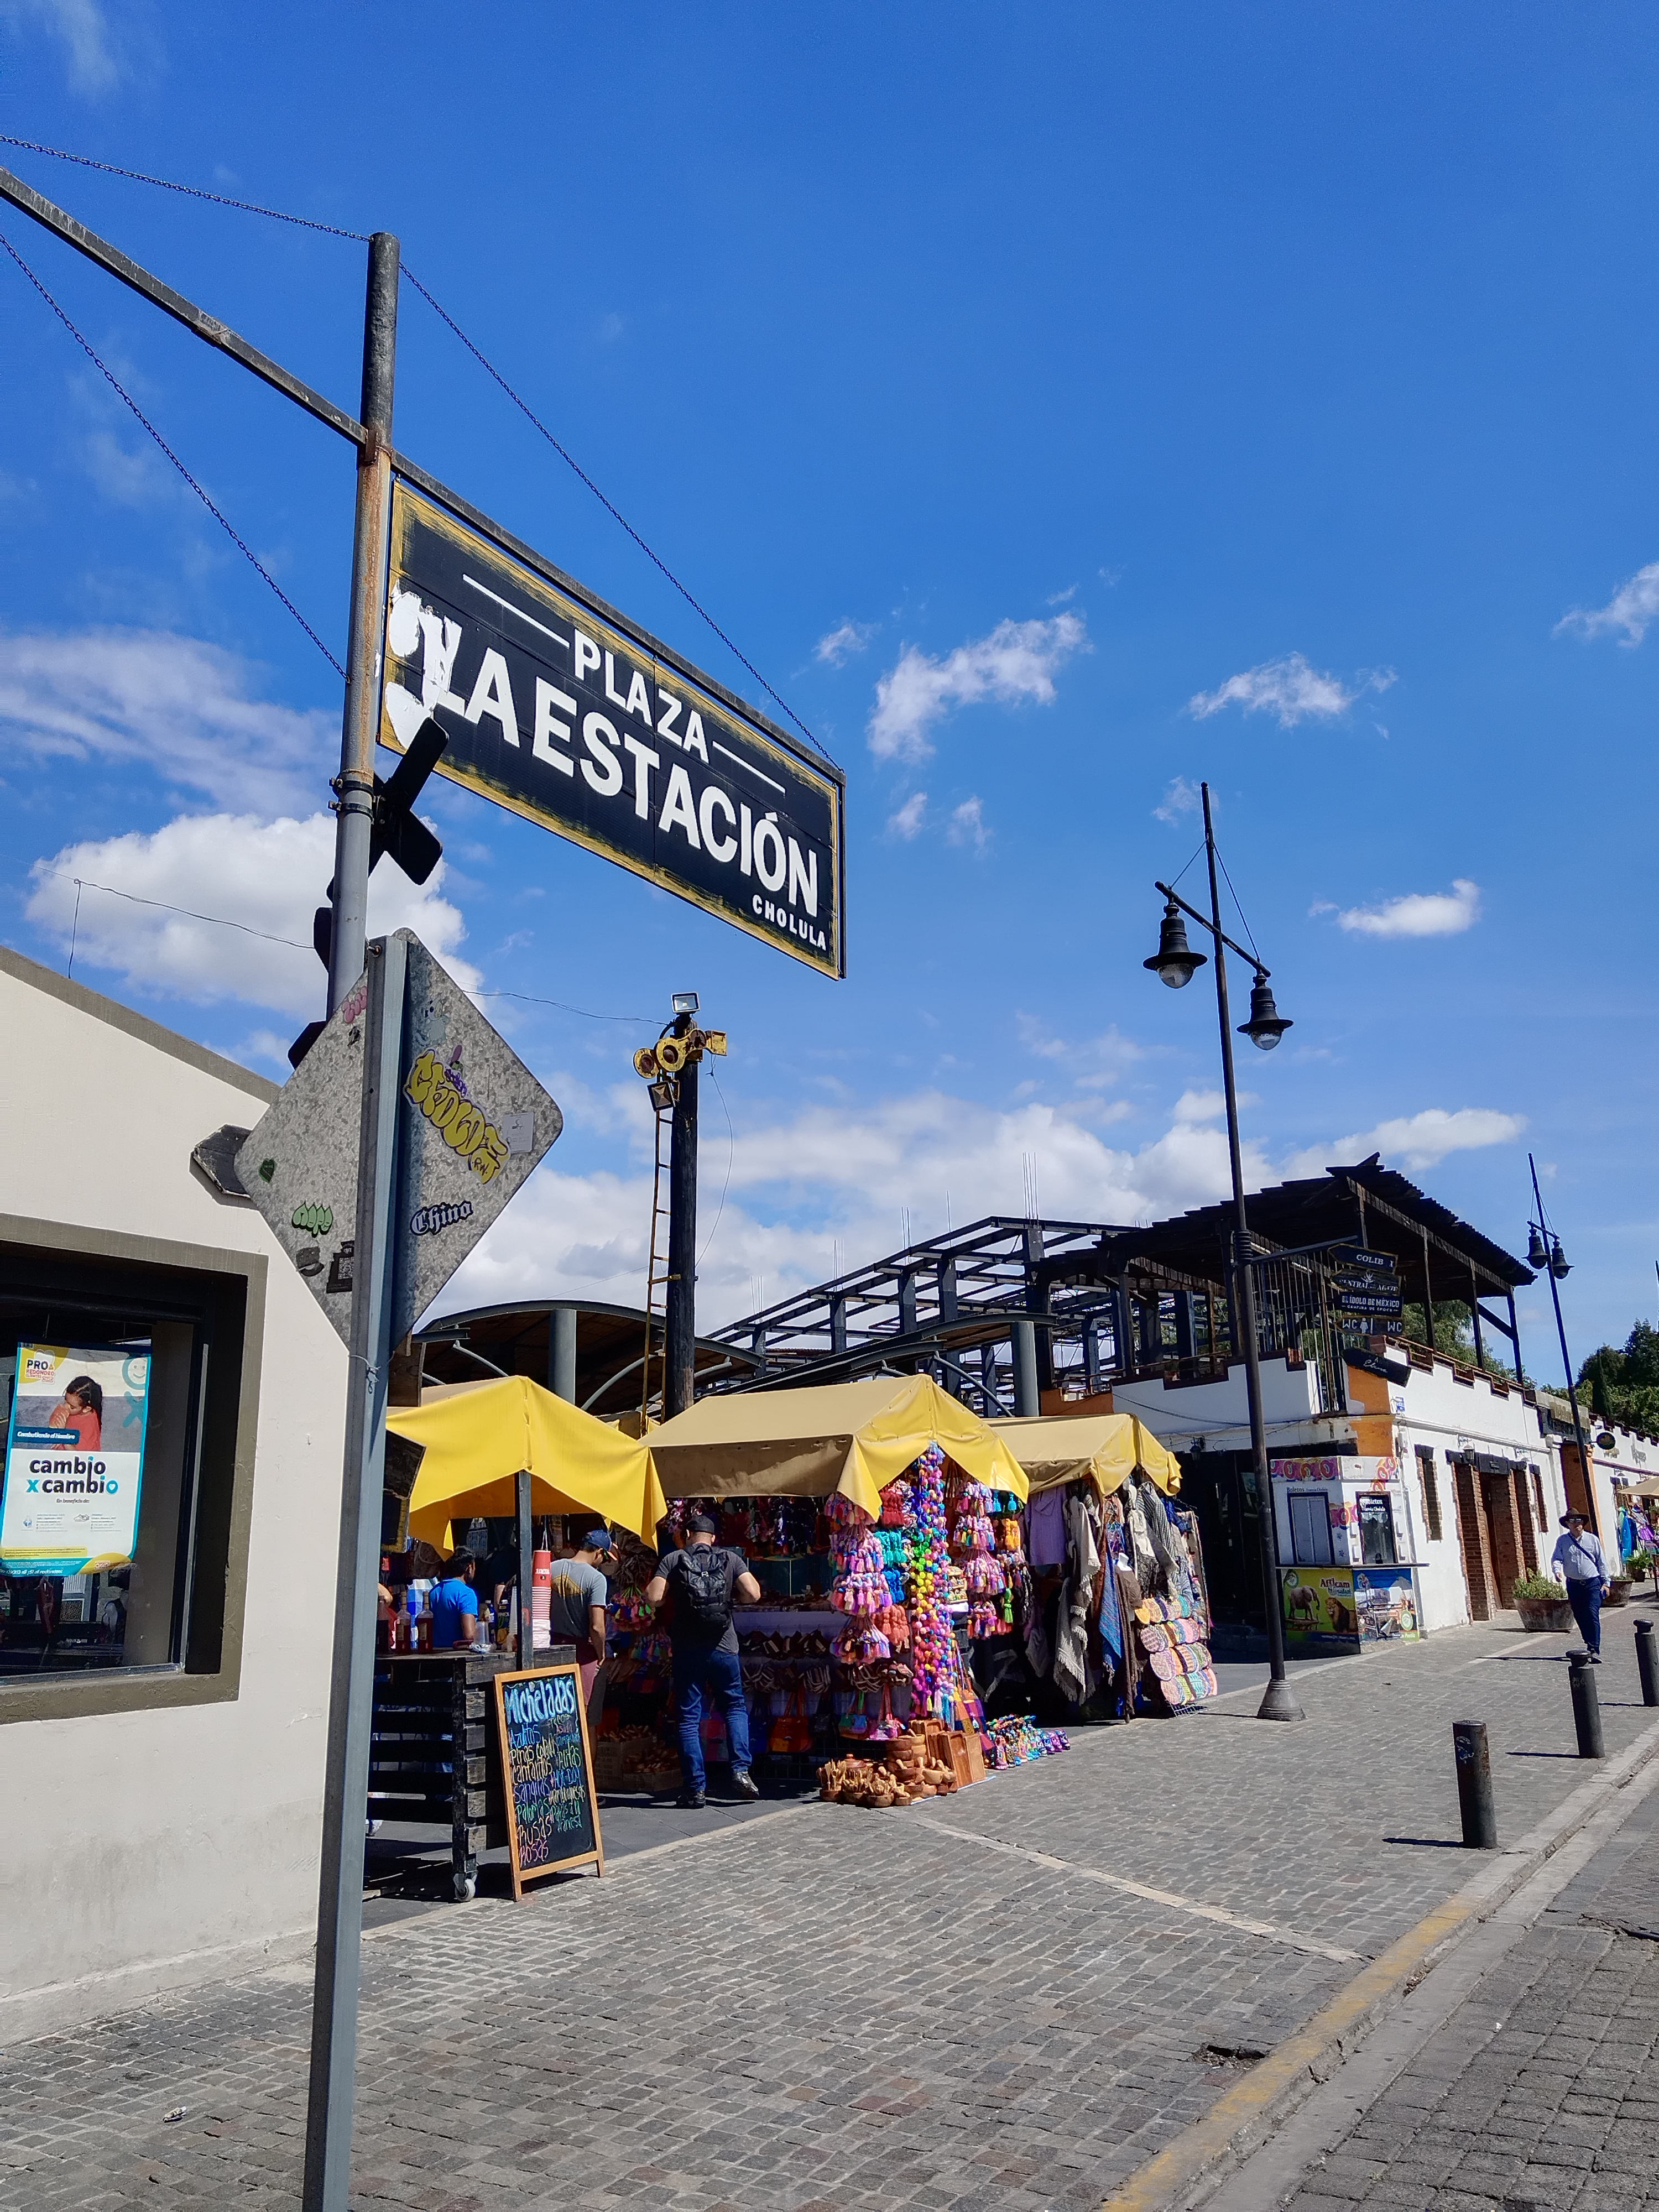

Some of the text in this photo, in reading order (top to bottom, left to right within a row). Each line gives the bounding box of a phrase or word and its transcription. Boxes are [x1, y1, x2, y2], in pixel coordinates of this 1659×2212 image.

[574, 628, 709, 763] PLAZA
[425, 615, 817, 917] LA ESTACIÓN
[753, 894, 826, 951] CHOLULA
[410, 1201, 473, 1236] Chino
[1357, 1254, 1394, 1267] COLIBI
[1349, 1295, 1366, 1305] ÍDOLO
[1376, 1297, 1400, 1308] MÉXICO
[1342, 1318, 1402, 1332] WC WC
[27, 1359, 48, 1370] PRO
[29, 1455, 106, 1475] cambio
[27, 1475, 118, 1494] x cambio
[504, 1678, 575, 1725] Micheladas
